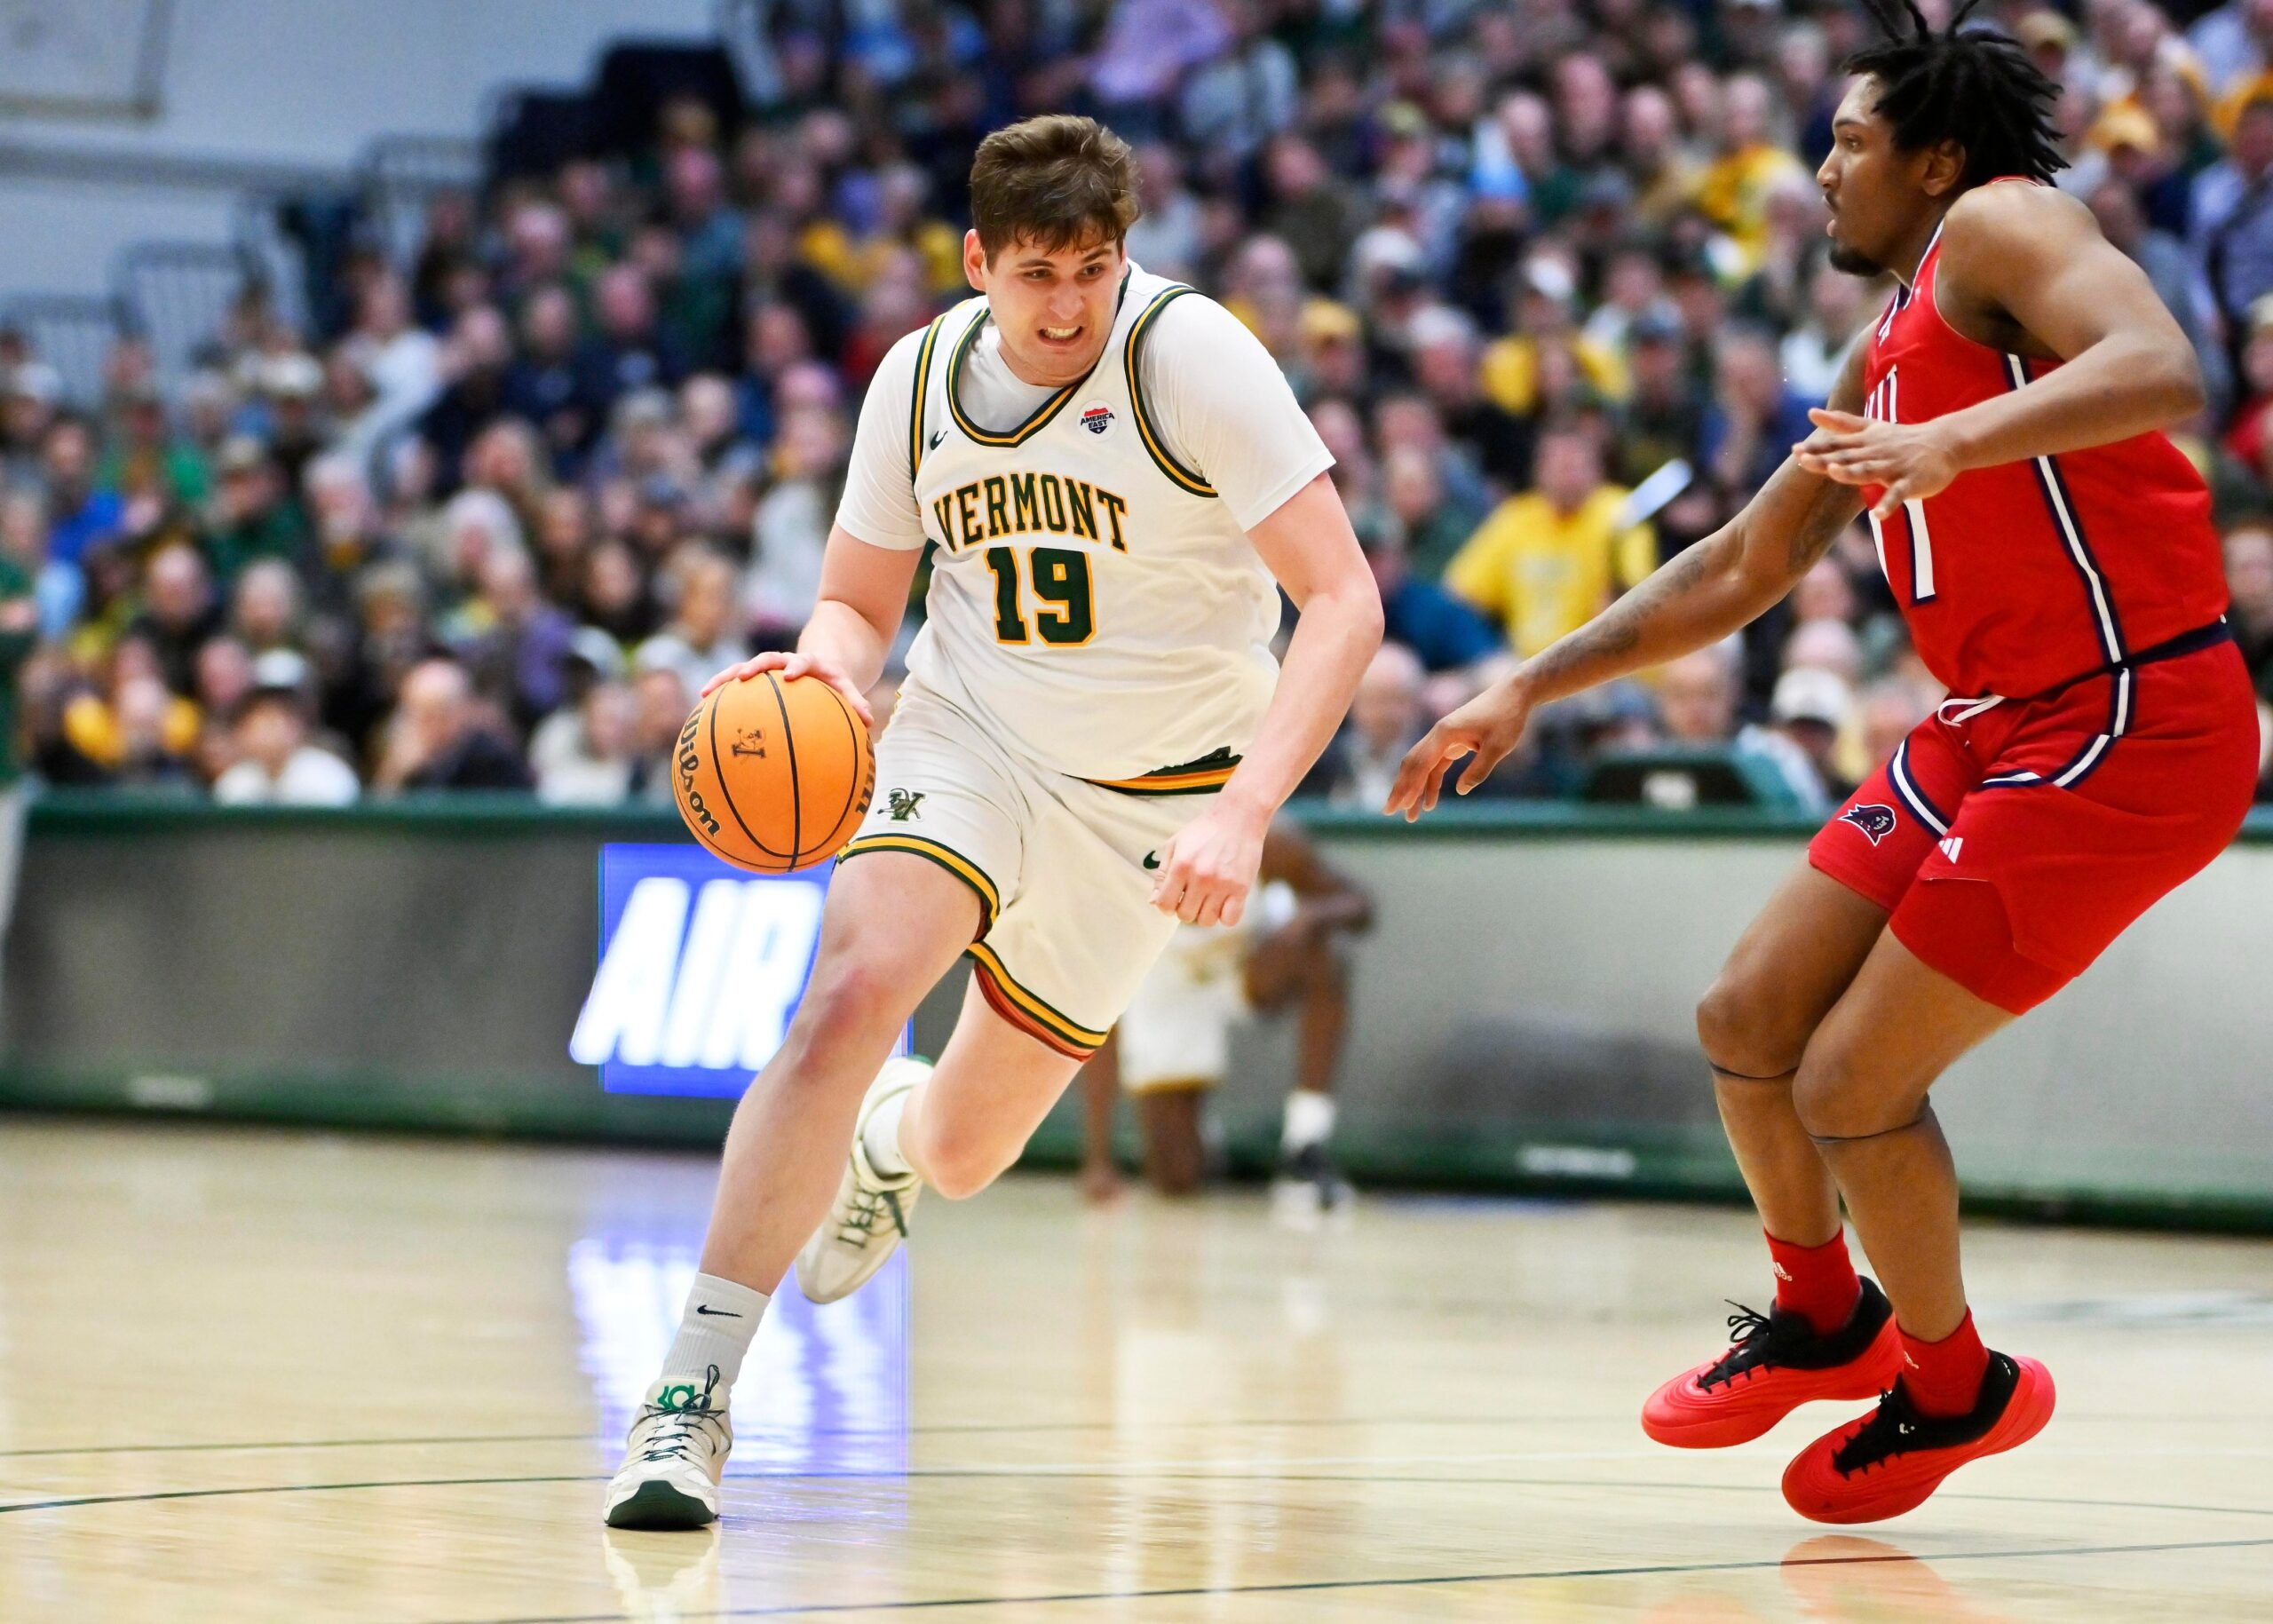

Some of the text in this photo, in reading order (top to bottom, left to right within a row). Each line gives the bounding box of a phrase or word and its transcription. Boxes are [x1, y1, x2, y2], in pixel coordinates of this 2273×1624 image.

[1080, 412, 1115, 426] AMERICA
[1088, 419, 1108, 429] EAST
[931, 471, 1129, 555] VERMONT
[983, 546, 1097, 648] 19
[679, 701, 722, 838] Wilson
